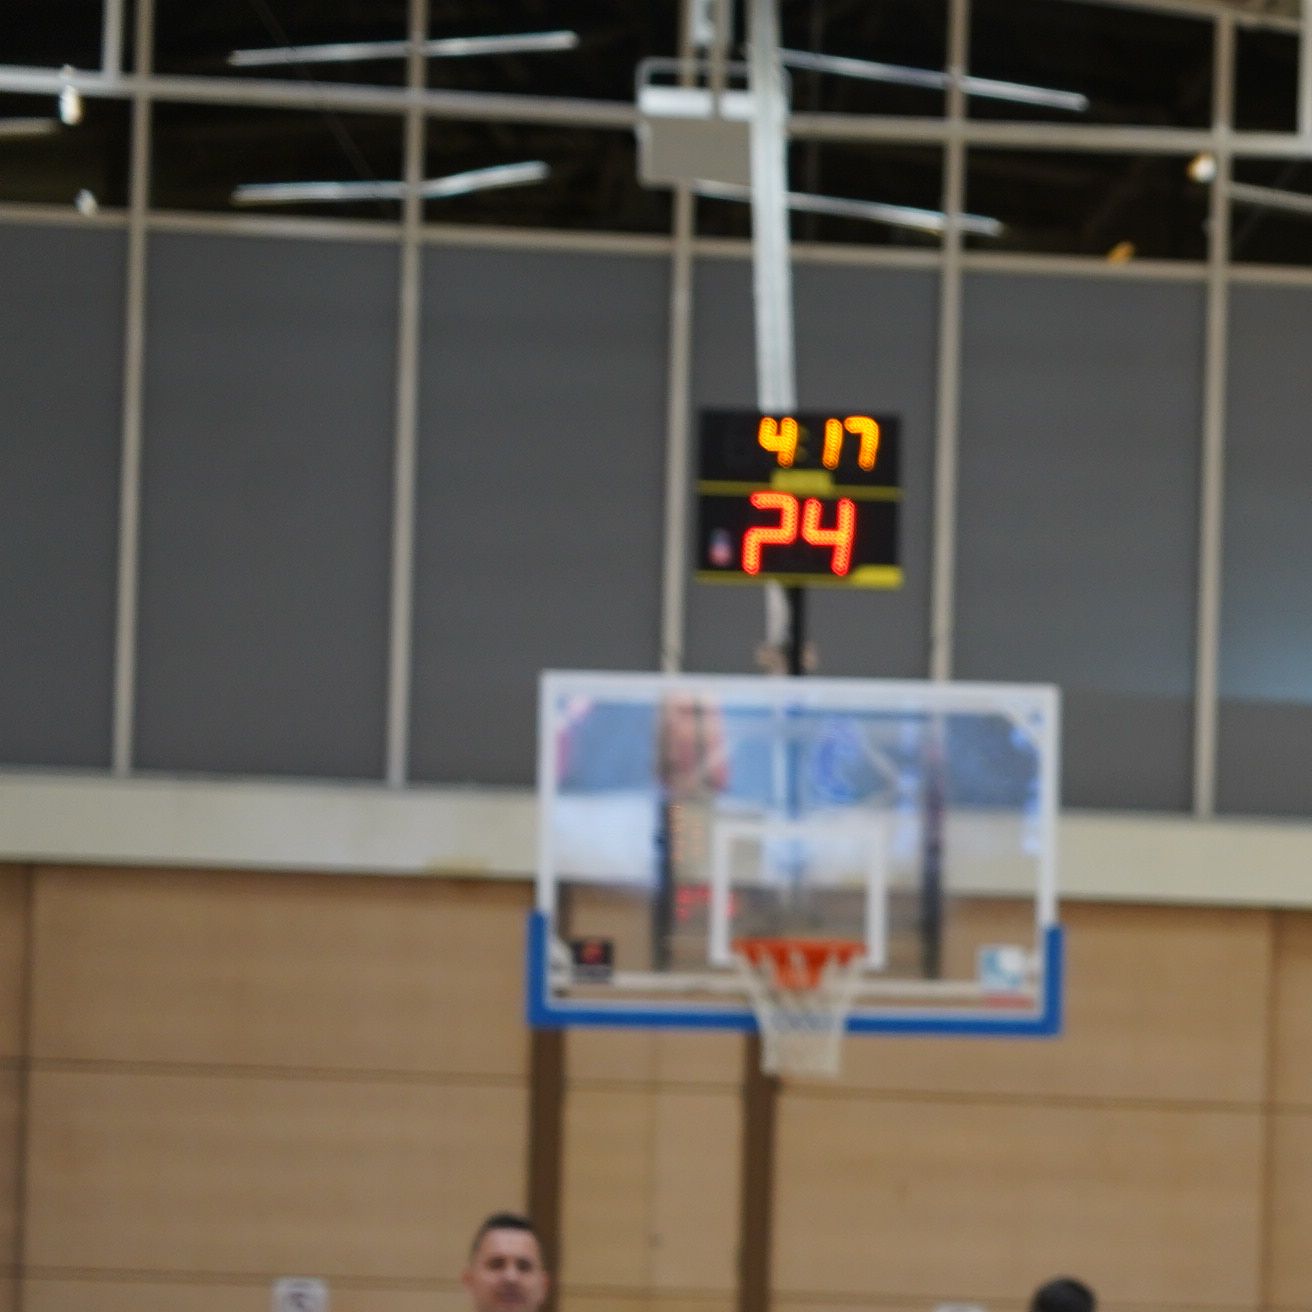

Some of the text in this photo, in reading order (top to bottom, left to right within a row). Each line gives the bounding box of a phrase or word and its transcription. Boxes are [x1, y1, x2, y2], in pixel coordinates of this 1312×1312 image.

[758, 416, 879, 471] 4 17
[742, 491, 856, 576] 24
